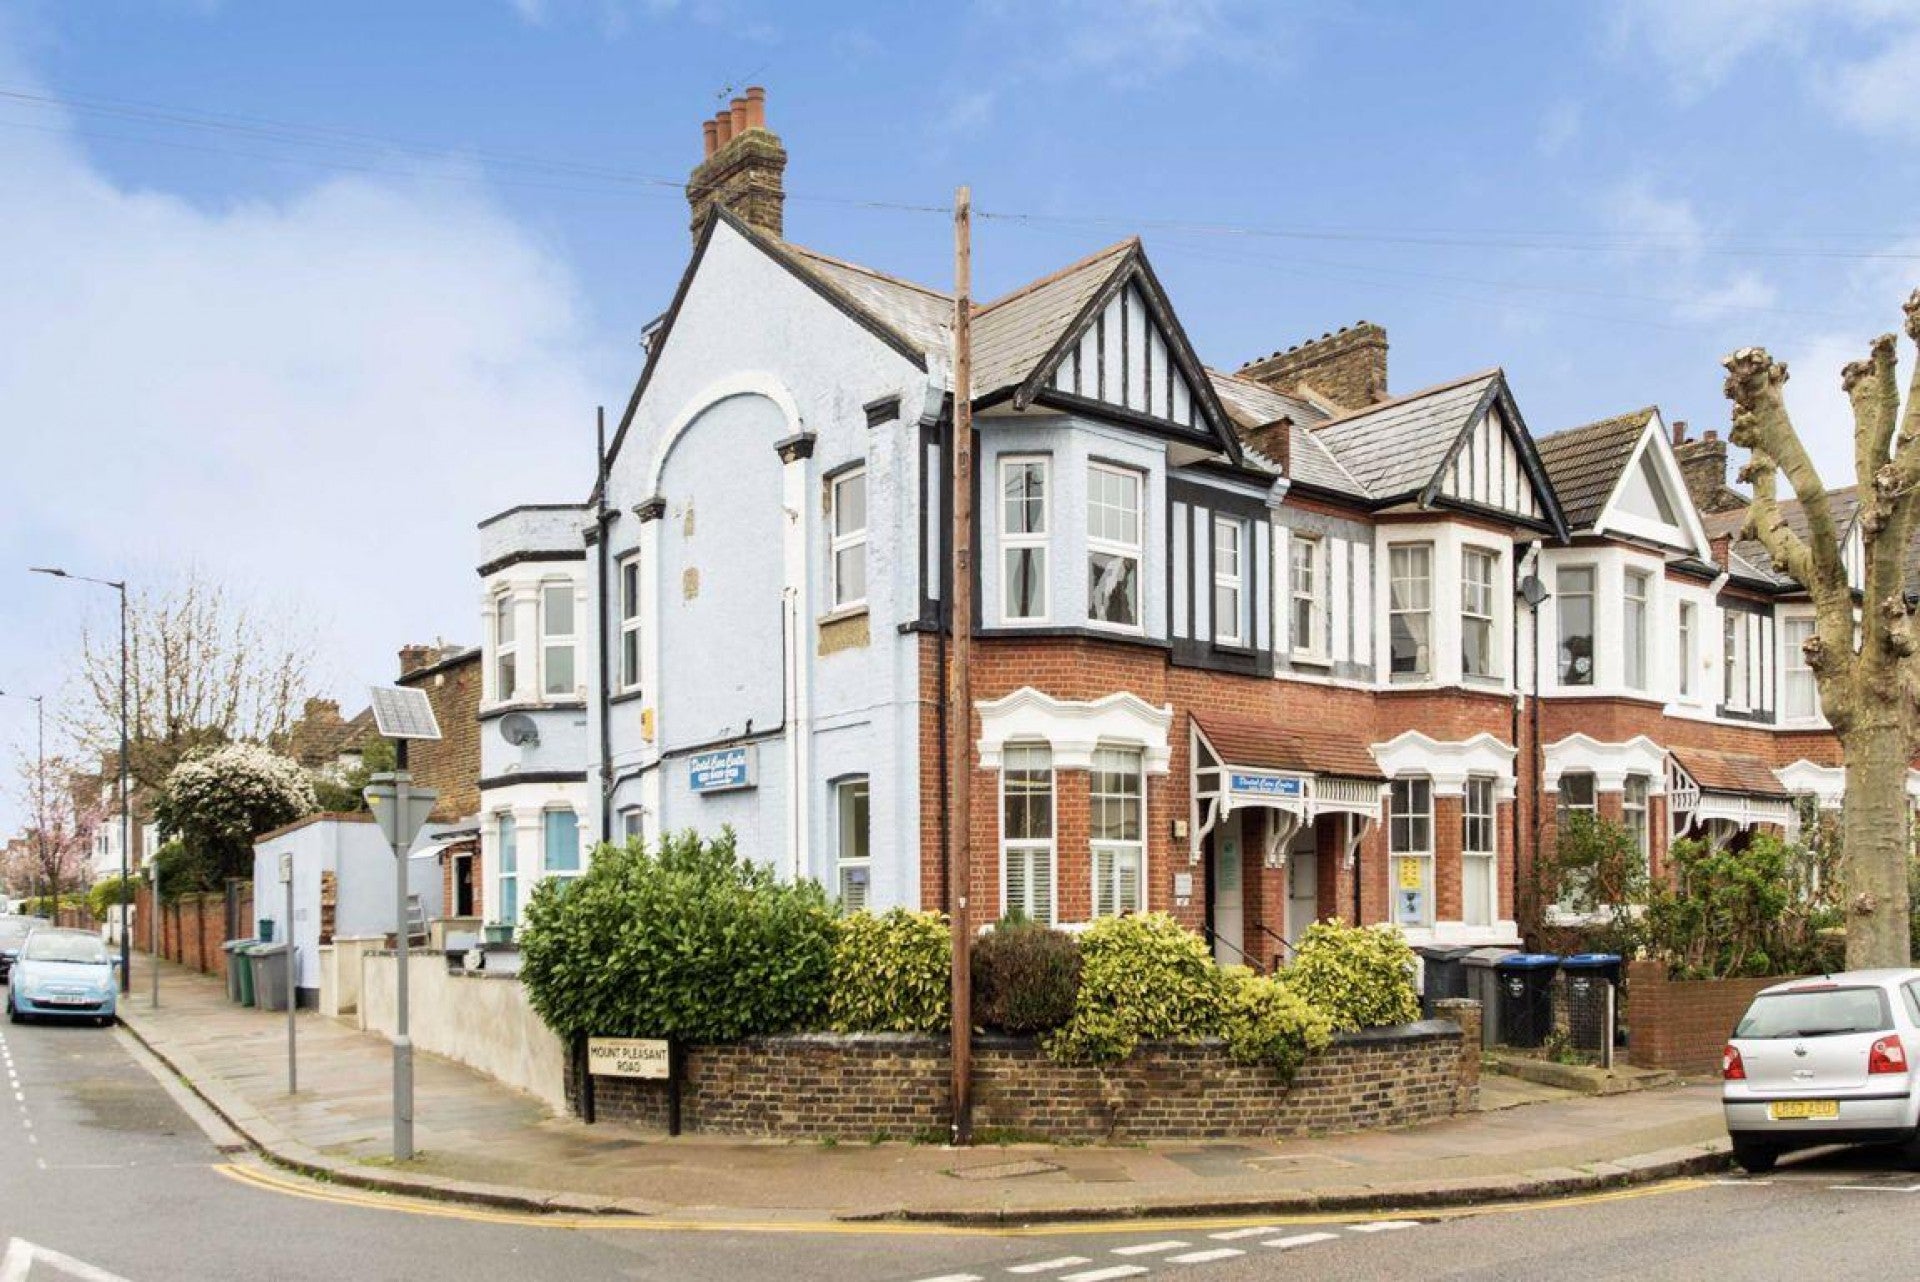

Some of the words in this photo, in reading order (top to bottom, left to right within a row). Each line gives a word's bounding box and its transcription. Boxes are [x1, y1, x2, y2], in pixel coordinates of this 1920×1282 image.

[590, 1045, 620, 1058] MOUNT
[622, 1047, 667, 1060] PLEASANT
[616, 1061, 641, 1073] ROAD
